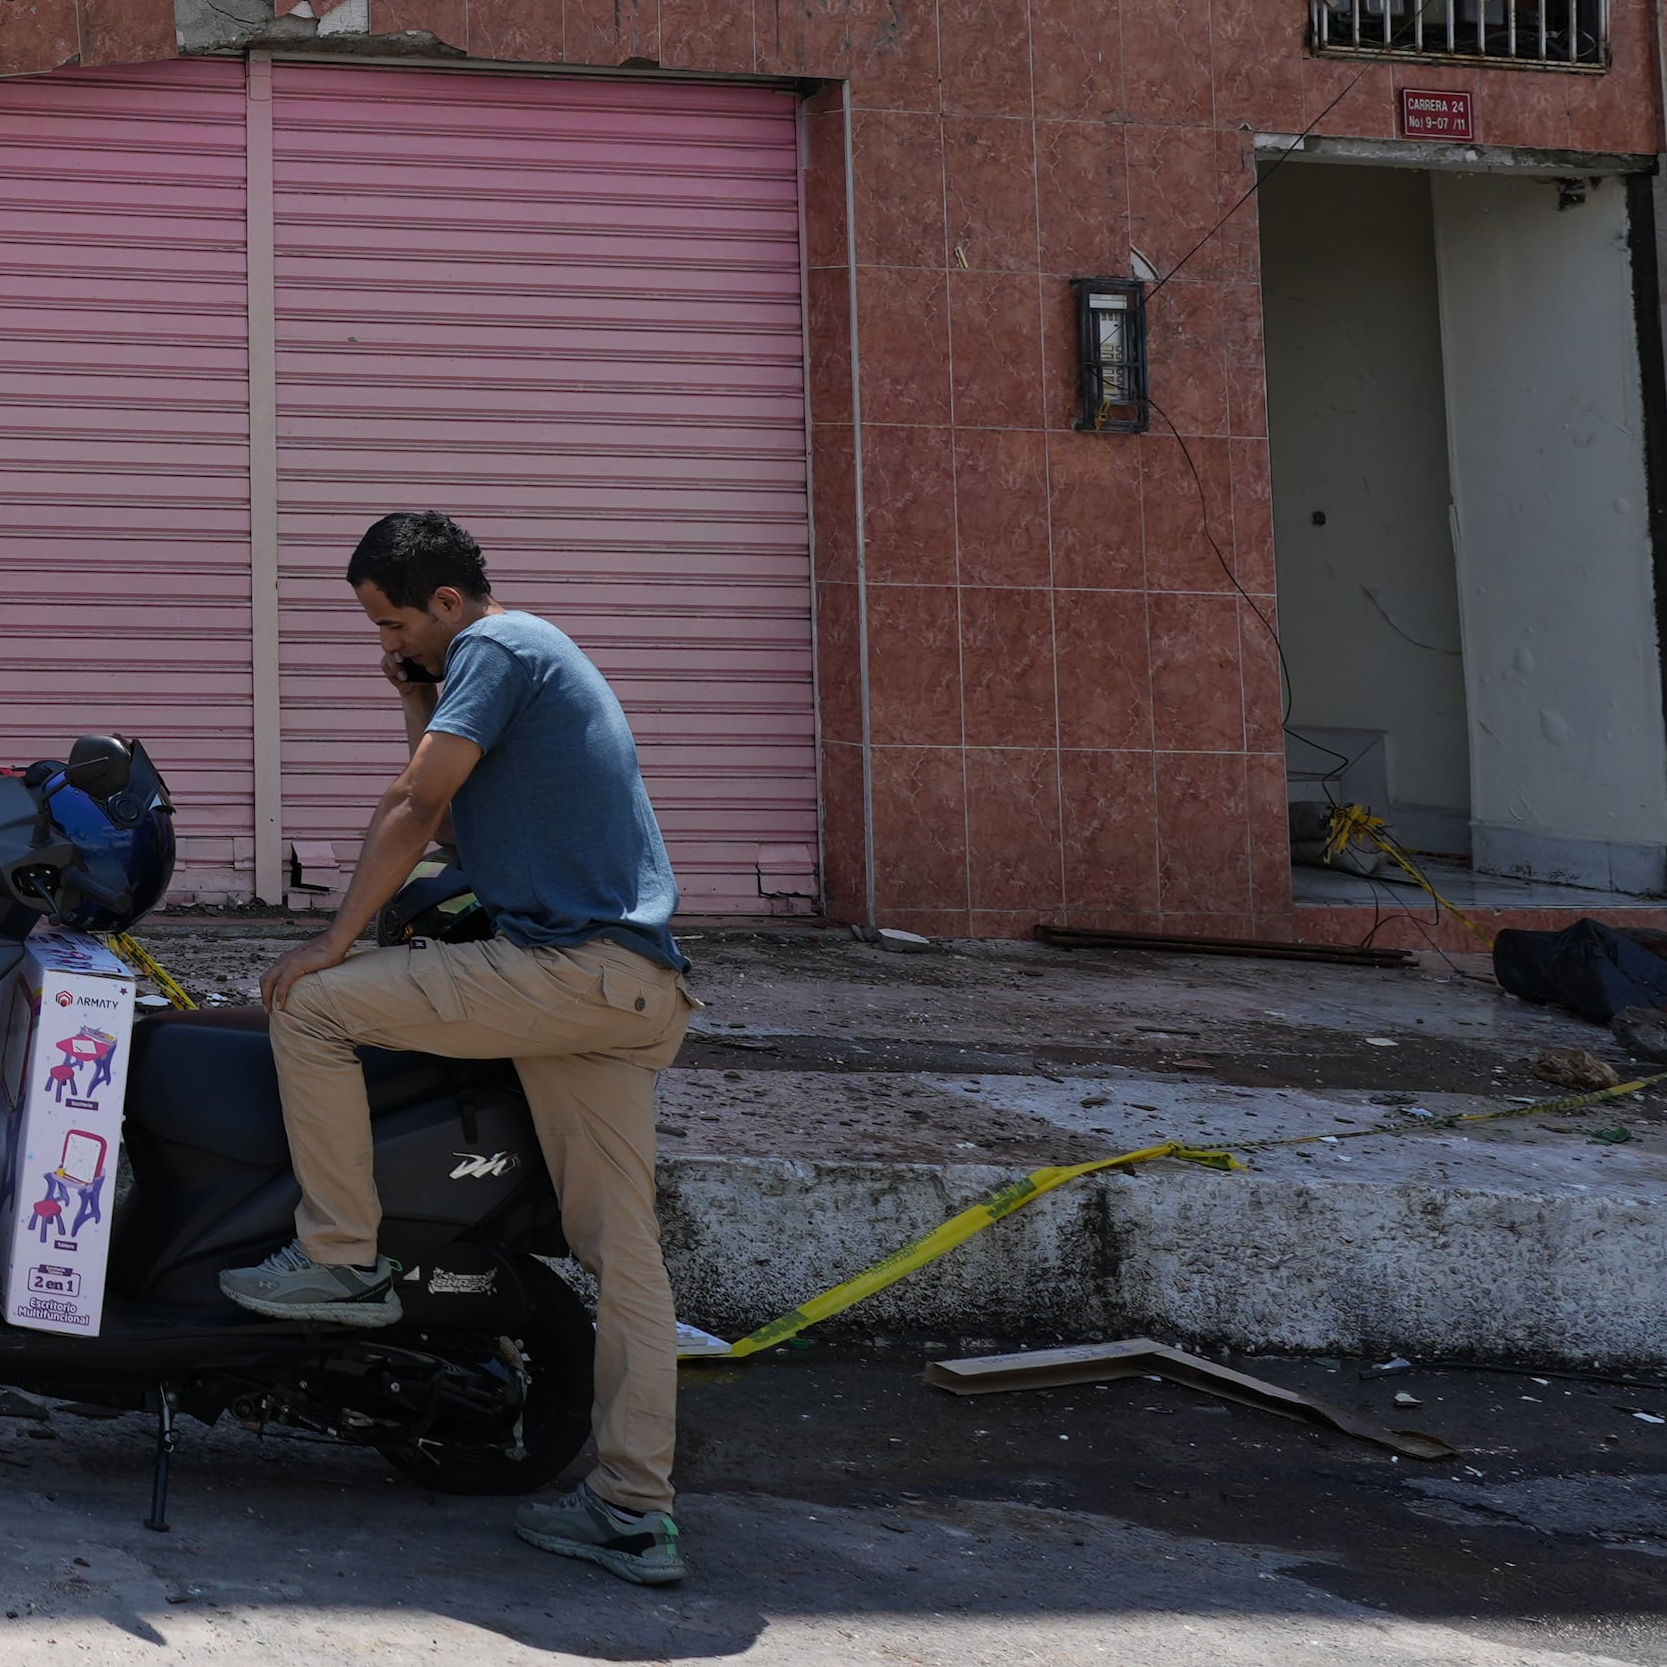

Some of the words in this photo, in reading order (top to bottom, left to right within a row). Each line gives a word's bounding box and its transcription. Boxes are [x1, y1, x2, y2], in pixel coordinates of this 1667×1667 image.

[1407, 97, 1449, 114] CARRERA
[1451, 100, 1465, 114] 24
[1425, 115, 1449, 131] 9-07
[1452, 117, 1467, 132] /11
[76, 995, 120, 1011] ARMATY
[33, 1275, 44, 1289] 2
[45, 1278, 64, 1291] en
[66, 1279, 74, 1293] 1
[28, 1296, 78, 1314] Escritorio
[17, 1305, 90, 1327] Multifuncional
